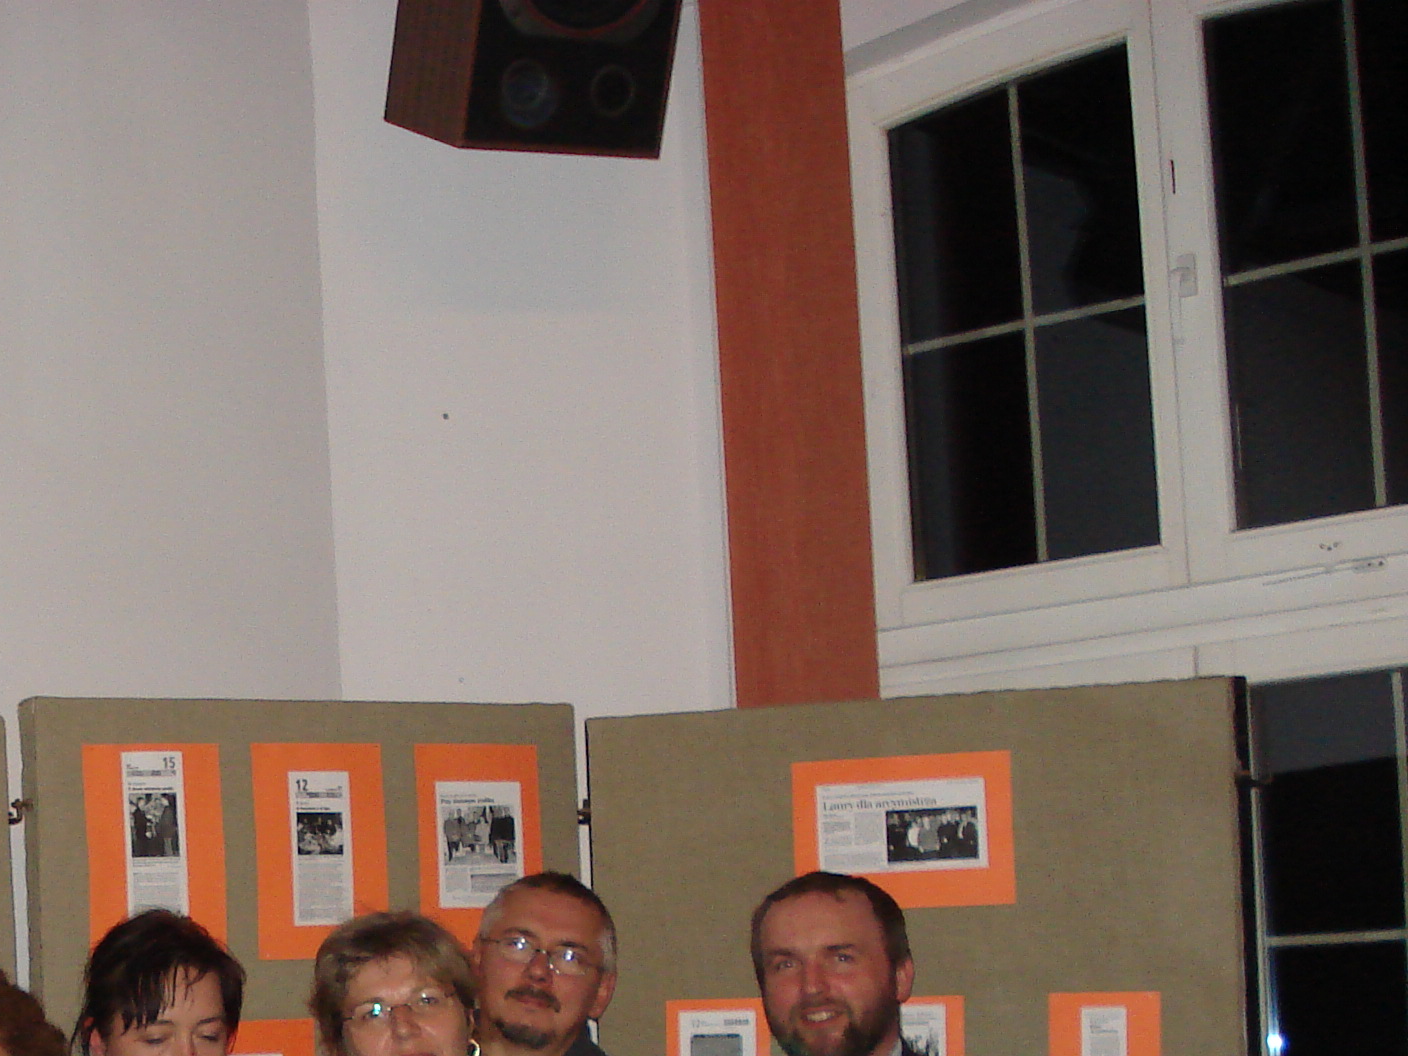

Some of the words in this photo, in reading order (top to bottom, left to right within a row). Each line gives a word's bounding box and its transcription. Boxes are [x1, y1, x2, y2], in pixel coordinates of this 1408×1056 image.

[163, 756, 175, 768] 15
[296, 779, 308, 791] 12
[856, 799, 873, 809] dla
